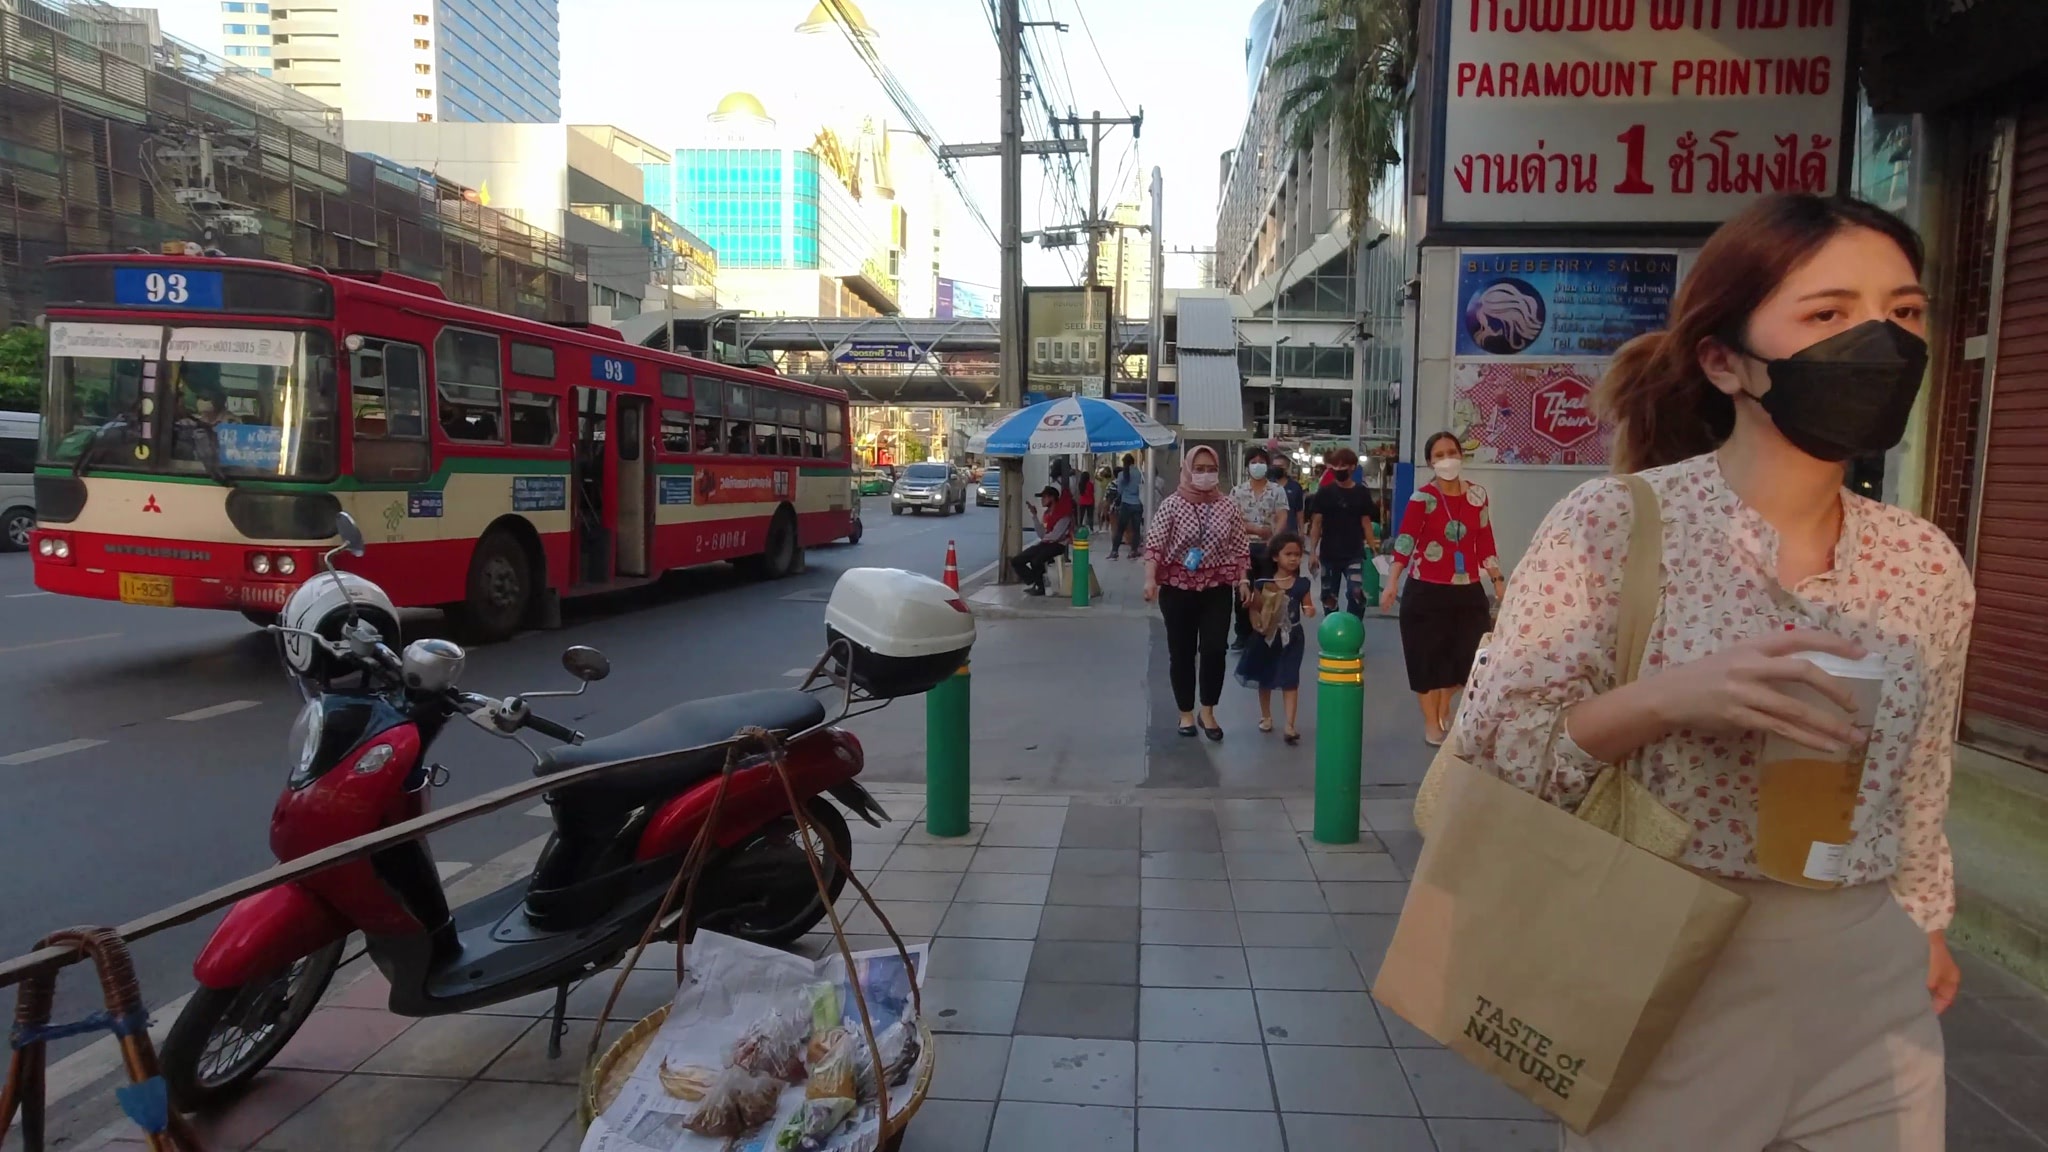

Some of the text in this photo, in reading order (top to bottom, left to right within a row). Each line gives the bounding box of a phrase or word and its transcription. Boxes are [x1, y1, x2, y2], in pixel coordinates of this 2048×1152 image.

[1457, 56, 1831, 98] PARAMOUNT PRINTING
[1453, 124, 1833, 195] งานด่วน 1 ชั่วโมงได้
[1467, 258, 1672, 275] BLUEBERRY SALON
[145, 272, 190, 304] 93
[1064, 322, 1104, 330] SEEDEE
[604, 360, 623, 382] 93
[1043, 414, 1082, 427] GF
[1122, 411, 1148, 424] GF
[1549, 410, 1597, 432] Town
[1476, 995, 1553, 1058] TASTE
[1464, 1015, 1575, 1100] NATURE
